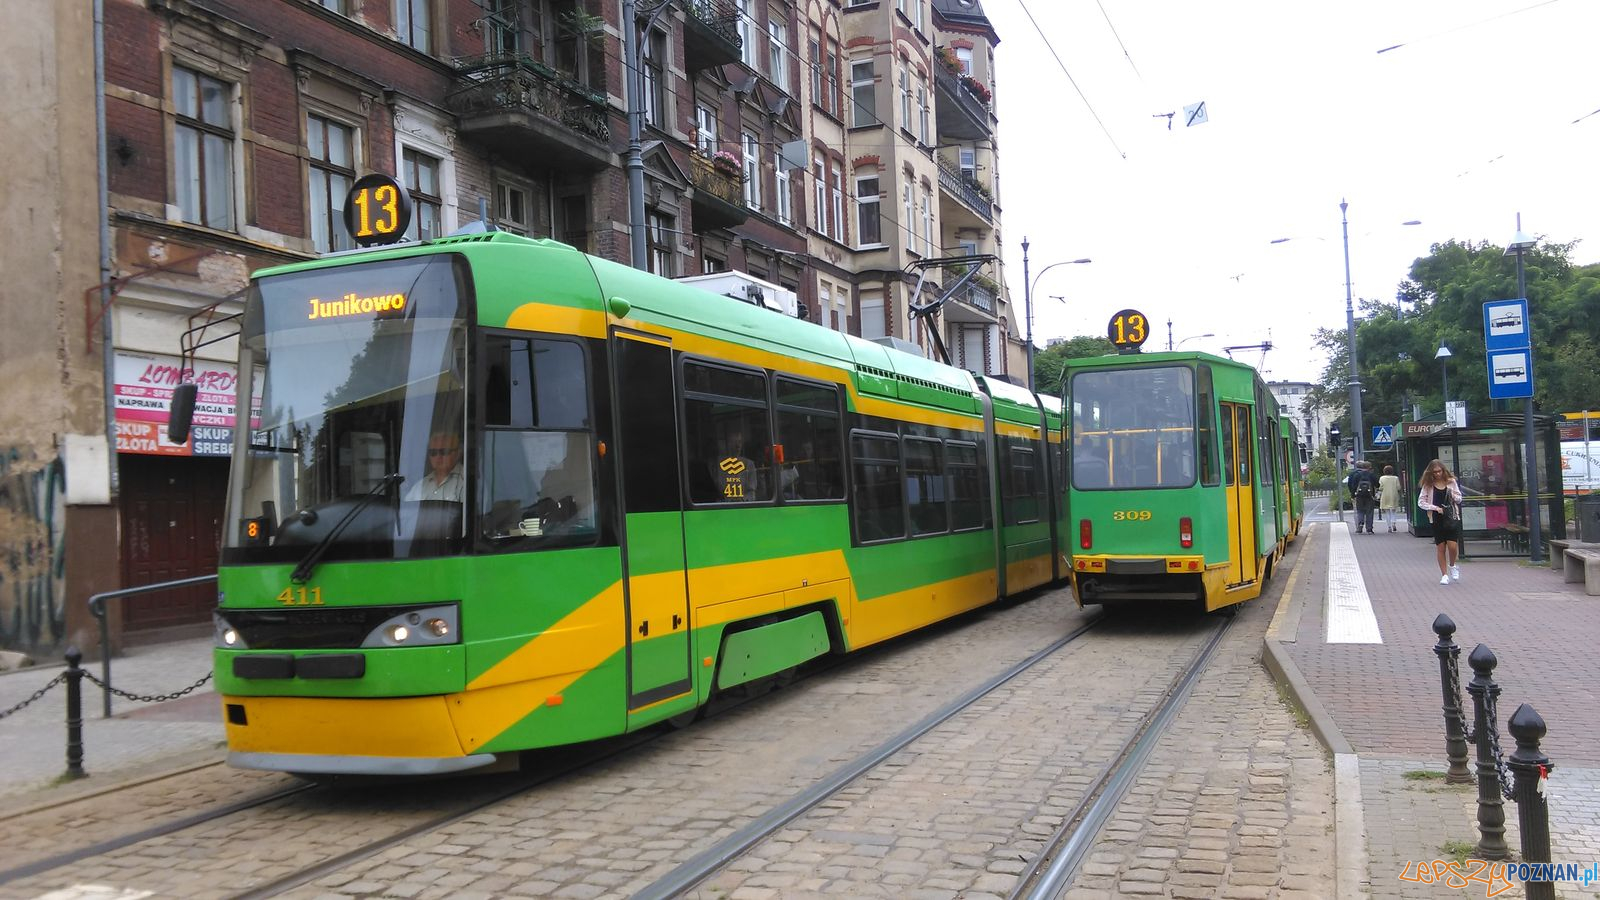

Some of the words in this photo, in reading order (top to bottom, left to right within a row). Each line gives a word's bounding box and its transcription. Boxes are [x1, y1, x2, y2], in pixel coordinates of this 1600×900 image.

[354, 185, 398, 237] 13
[308, 293, 404, 319] Junikowo
[1113, 314, 1145, 344] 13
[120, 386, 147, 395] SKUP
[201, 394, 229, 403] ZŁOTA
[118, 399, 164, 408] NAPRAWA
[194, 405, 223, 414] WACJA
[193, 415, 225, 425] YCZKI
[115, 423, 150, 436] SKUP
[194, 428, 229, 440] SKUP
[115, 437, 157, 451] ZŁOTA
[724, 484, 744, 498] 411
[1113, 510, 1151, 521] 309
[248, 521, 258, 537] 8
[277, 586, 324, 606] 411
